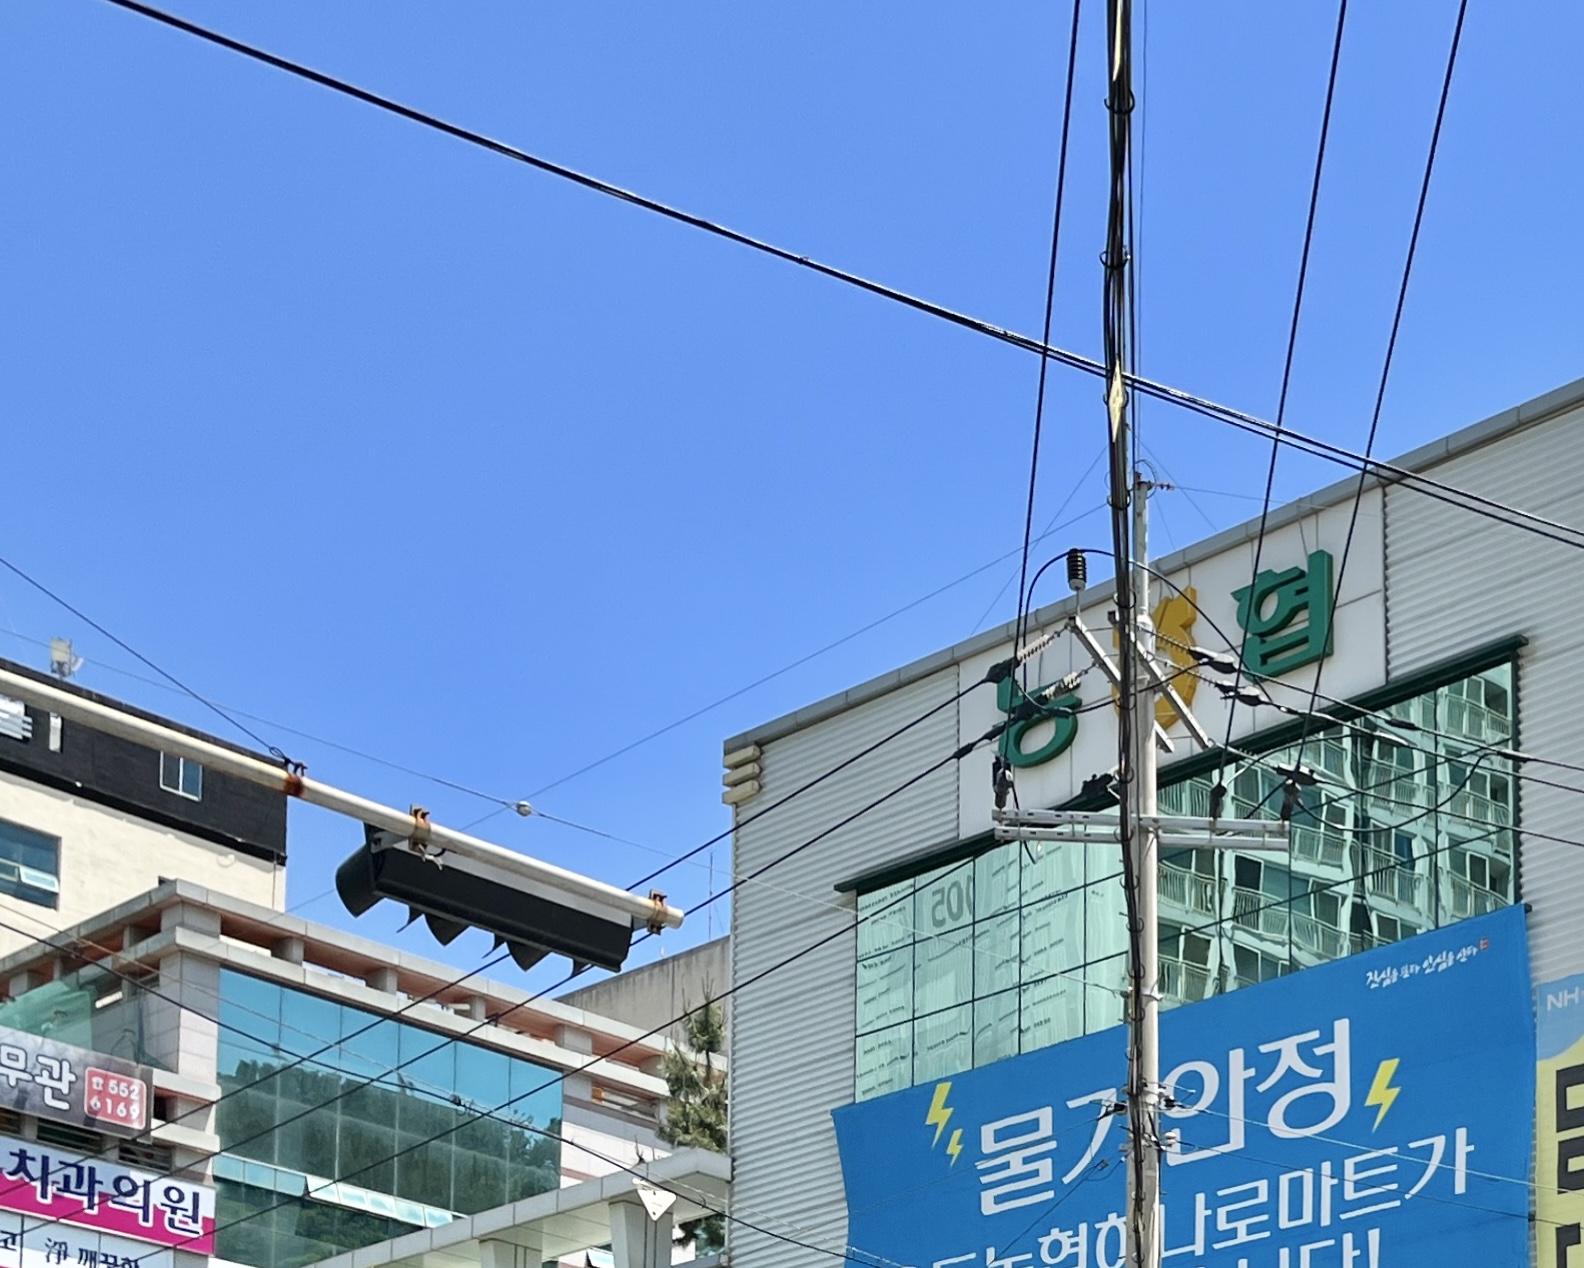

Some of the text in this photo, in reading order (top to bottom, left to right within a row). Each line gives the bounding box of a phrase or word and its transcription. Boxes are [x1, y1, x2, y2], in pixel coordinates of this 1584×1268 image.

[1546, 986, 1580, 1011] NH
[0, 1042, 77, 1111] 무관
[108, 1077, 140, 1100] 552
[89, 1097, 140, 1120] 6169
[6, 1148, 202, 1235] 치과의원
